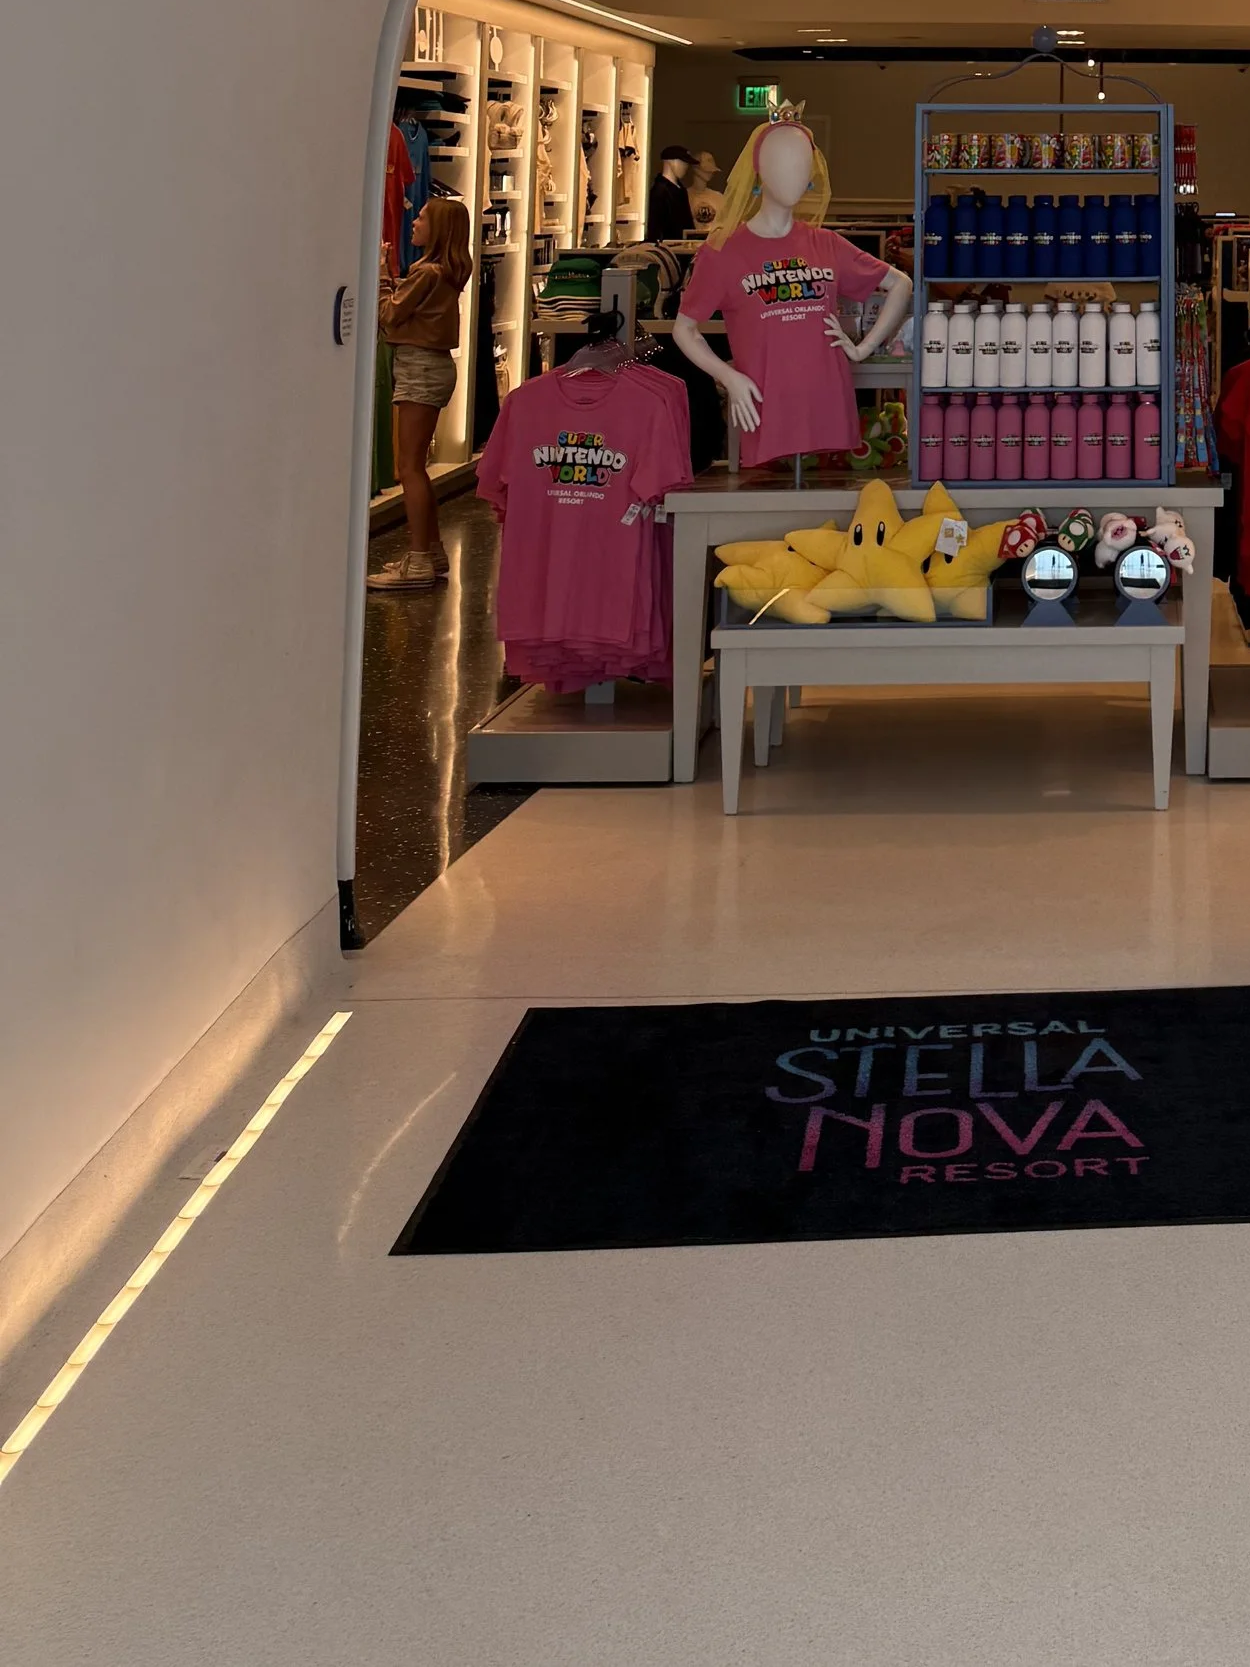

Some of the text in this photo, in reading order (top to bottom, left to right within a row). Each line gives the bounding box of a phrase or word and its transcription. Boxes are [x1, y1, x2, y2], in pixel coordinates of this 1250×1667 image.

[763, 257, 808, 272] SUPER
[742, 267, 834, 294] NINTENDO
[758, 282, 826, 303] WORLD
[558, 431, 604, 447] SUPER
[809, 1019, 1106, 1042] UNIVERSAL
[764, 1037, 1143, 1104] STELLA
[798, 1099, 1146, 1172] NOVA
[900, 1156, 1150, 1184] RESORT
